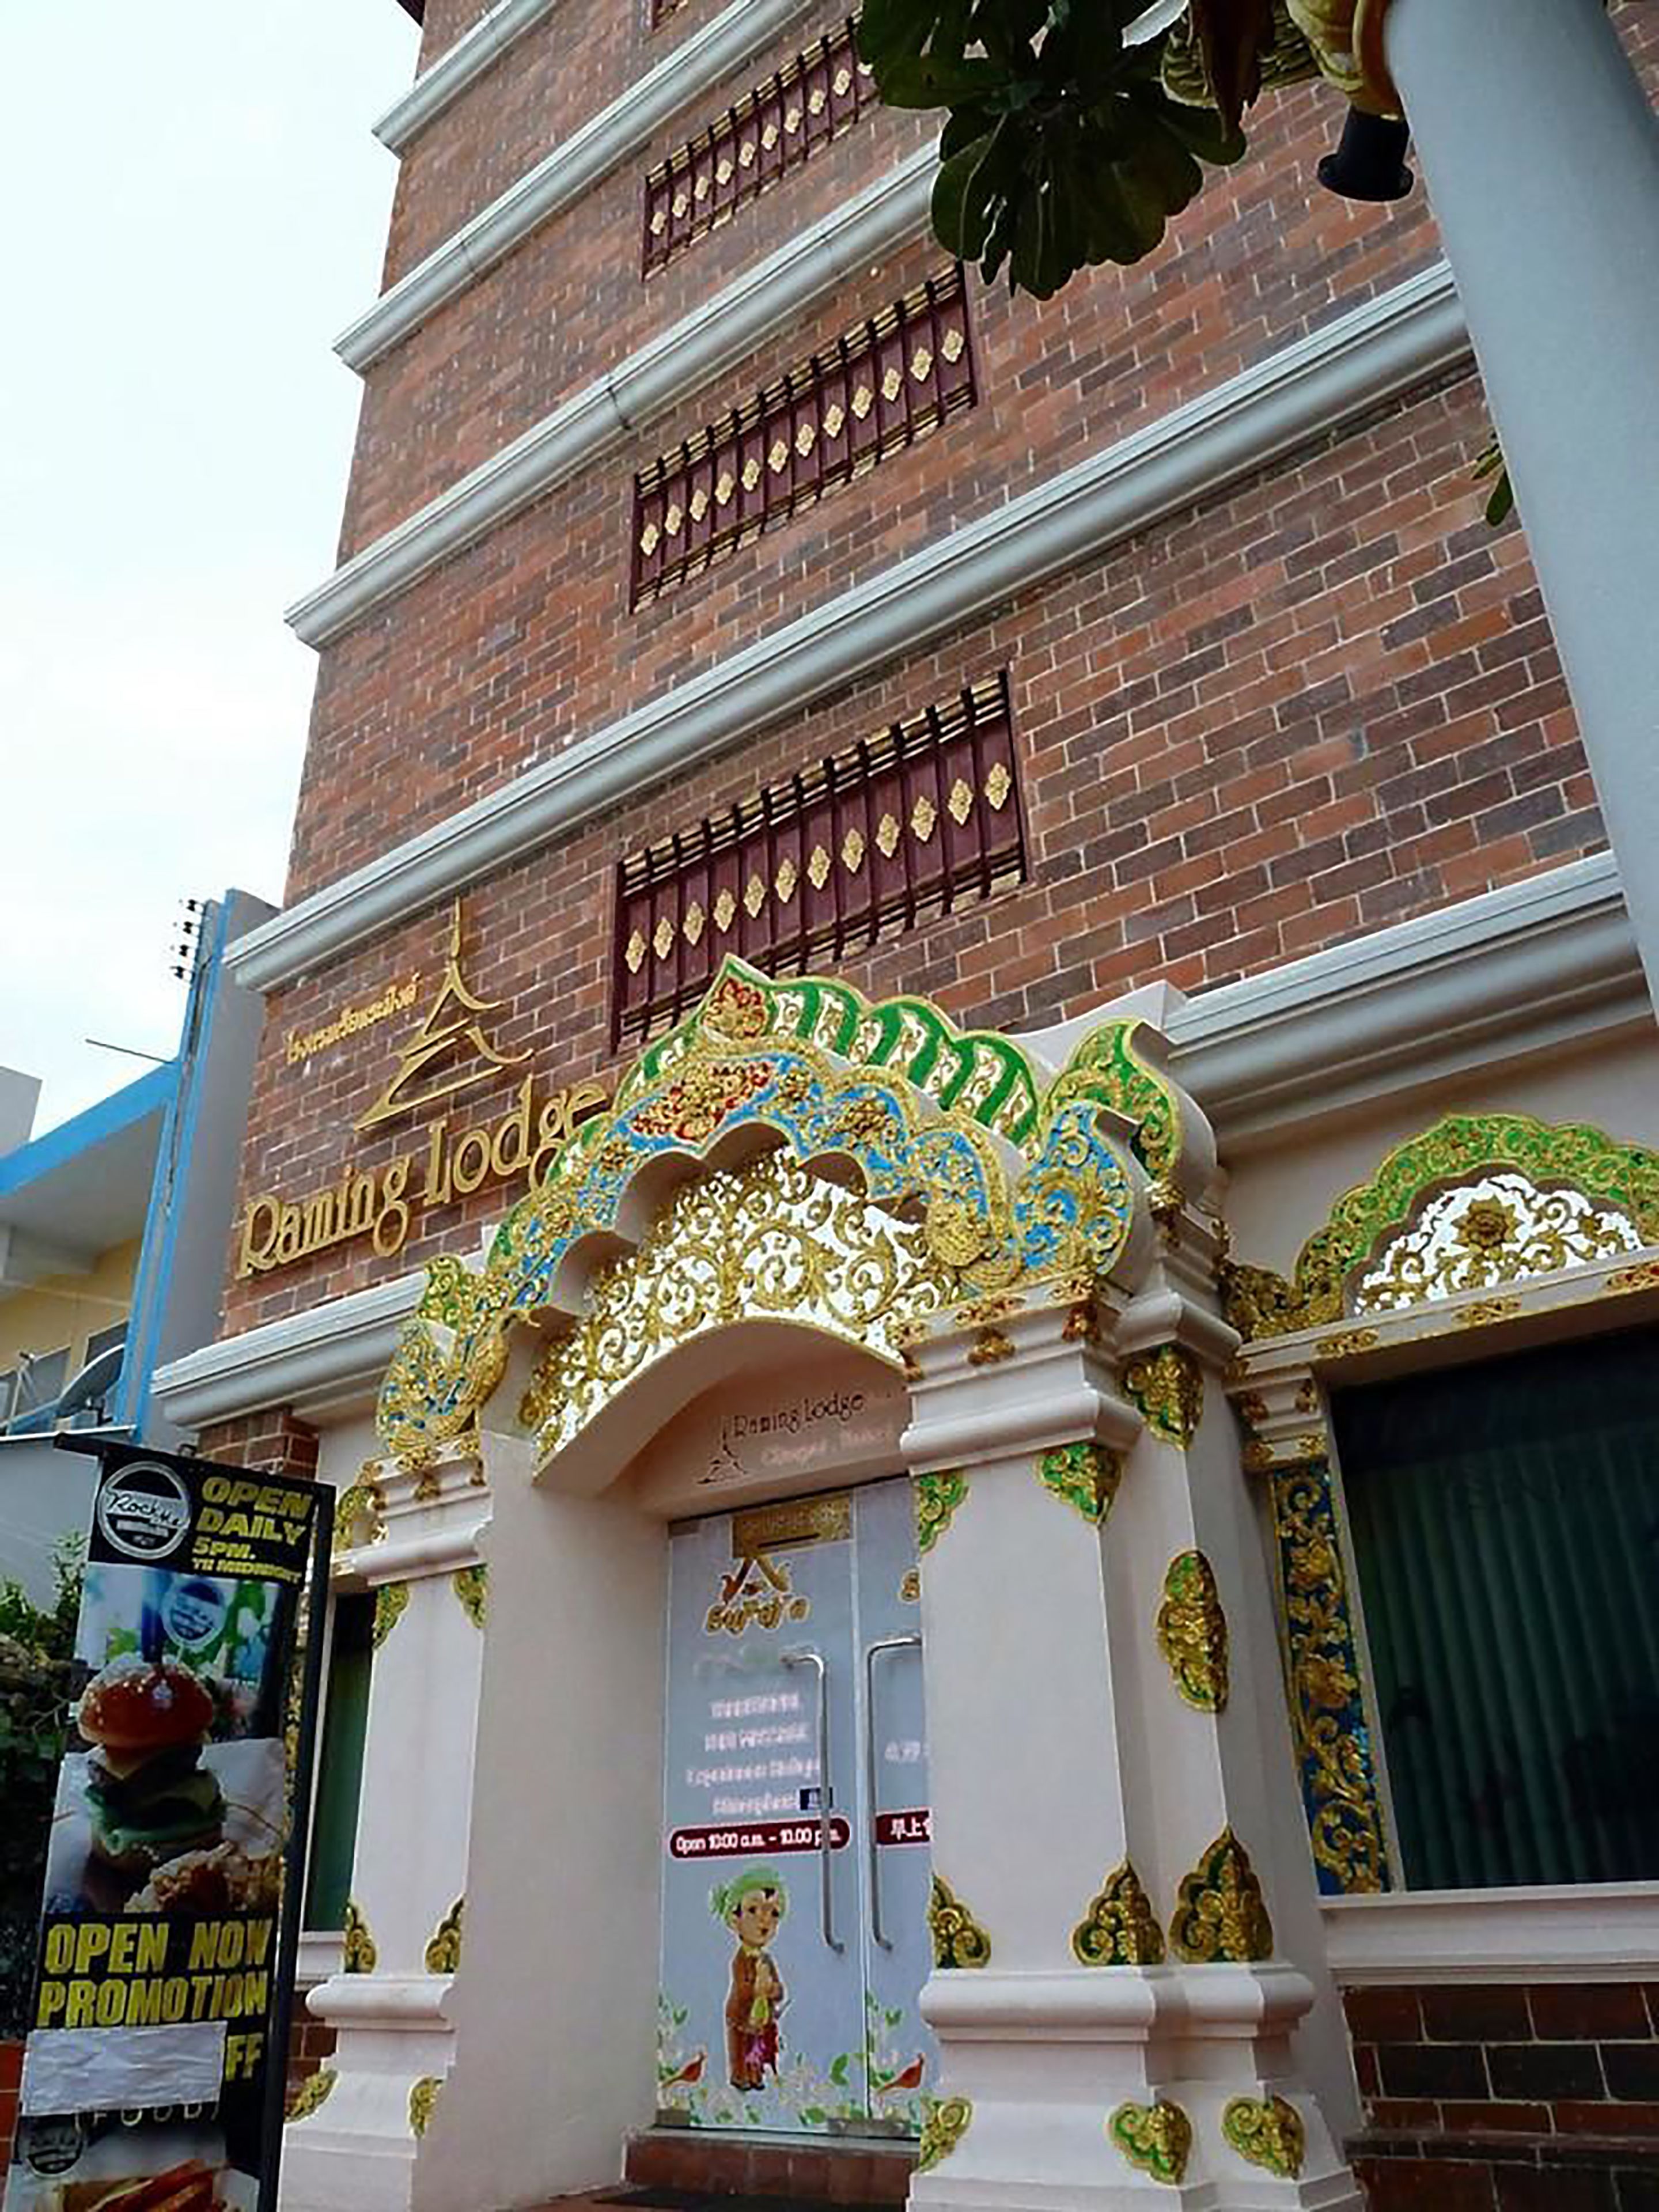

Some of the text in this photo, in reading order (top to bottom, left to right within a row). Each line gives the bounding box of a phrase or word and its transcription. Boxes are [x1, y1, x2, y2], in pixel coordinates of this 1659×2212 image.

[235, 1156, 410, 1280] Raming
[202, 1476, 313, 1520] OPEN
[195, 1506, 306, 1545] DAILY
[45, 1919, 273, 1973] OPEN NOW
[36, 1971, 268, 2028] PROMOTION
